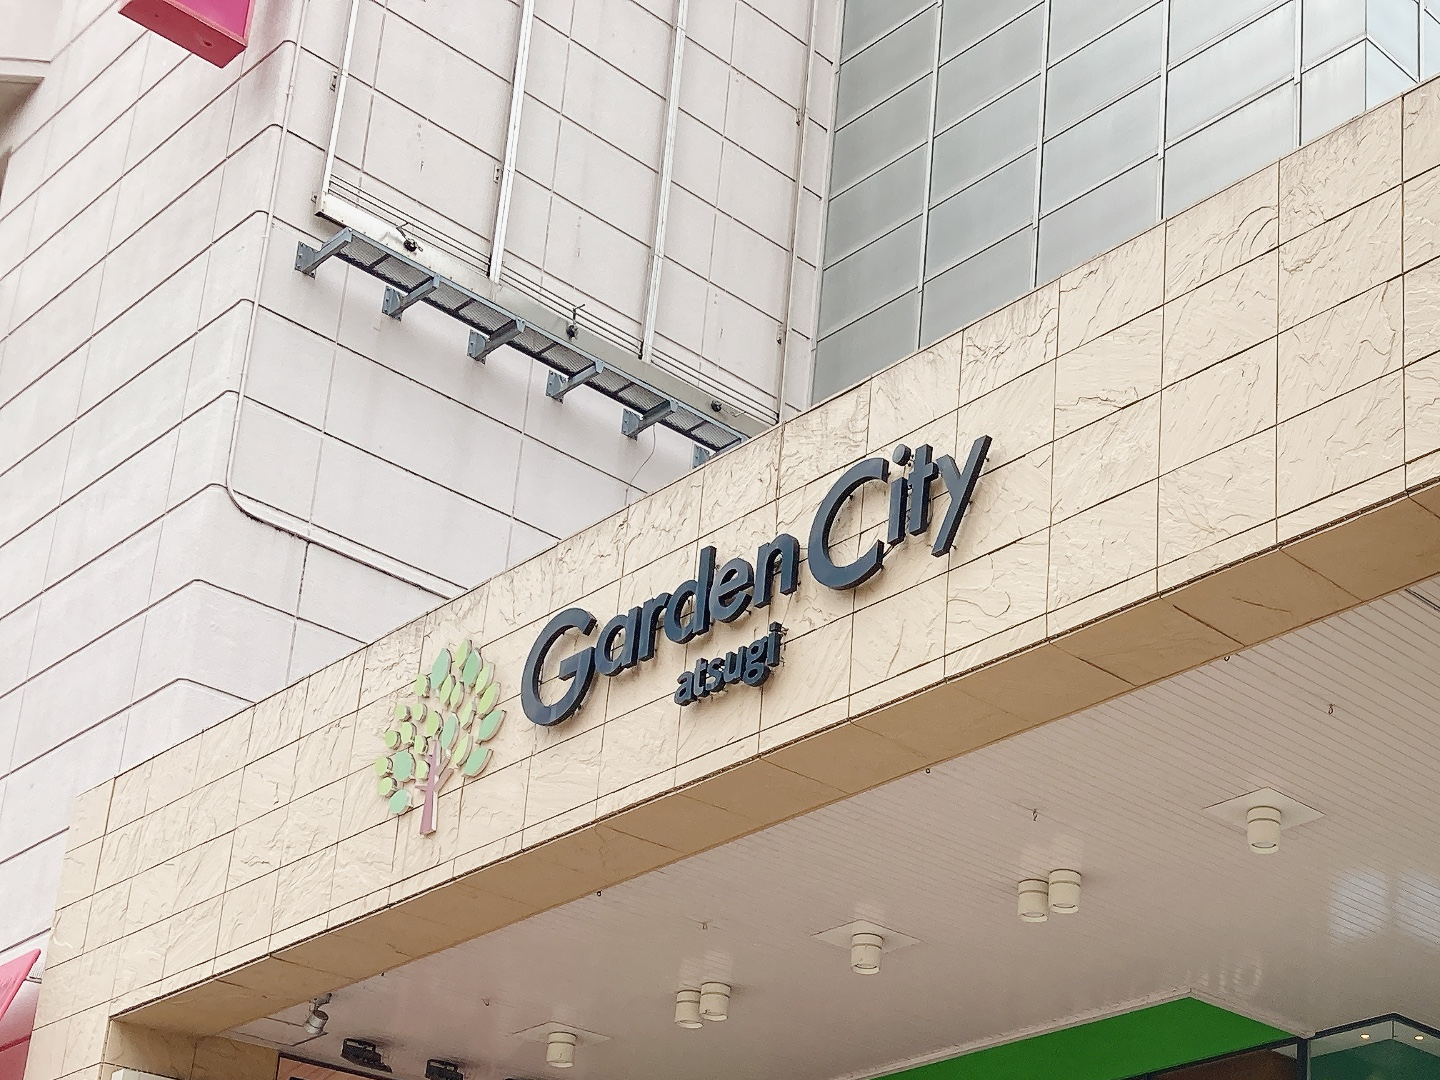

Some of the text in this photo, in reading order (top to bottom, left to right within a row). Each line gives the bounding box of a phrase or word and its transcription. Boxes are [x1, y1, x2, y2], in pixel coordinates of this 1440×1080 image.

[521, 435, 991, 726] Garden City
[674, 622, 786, 707] atsugi
